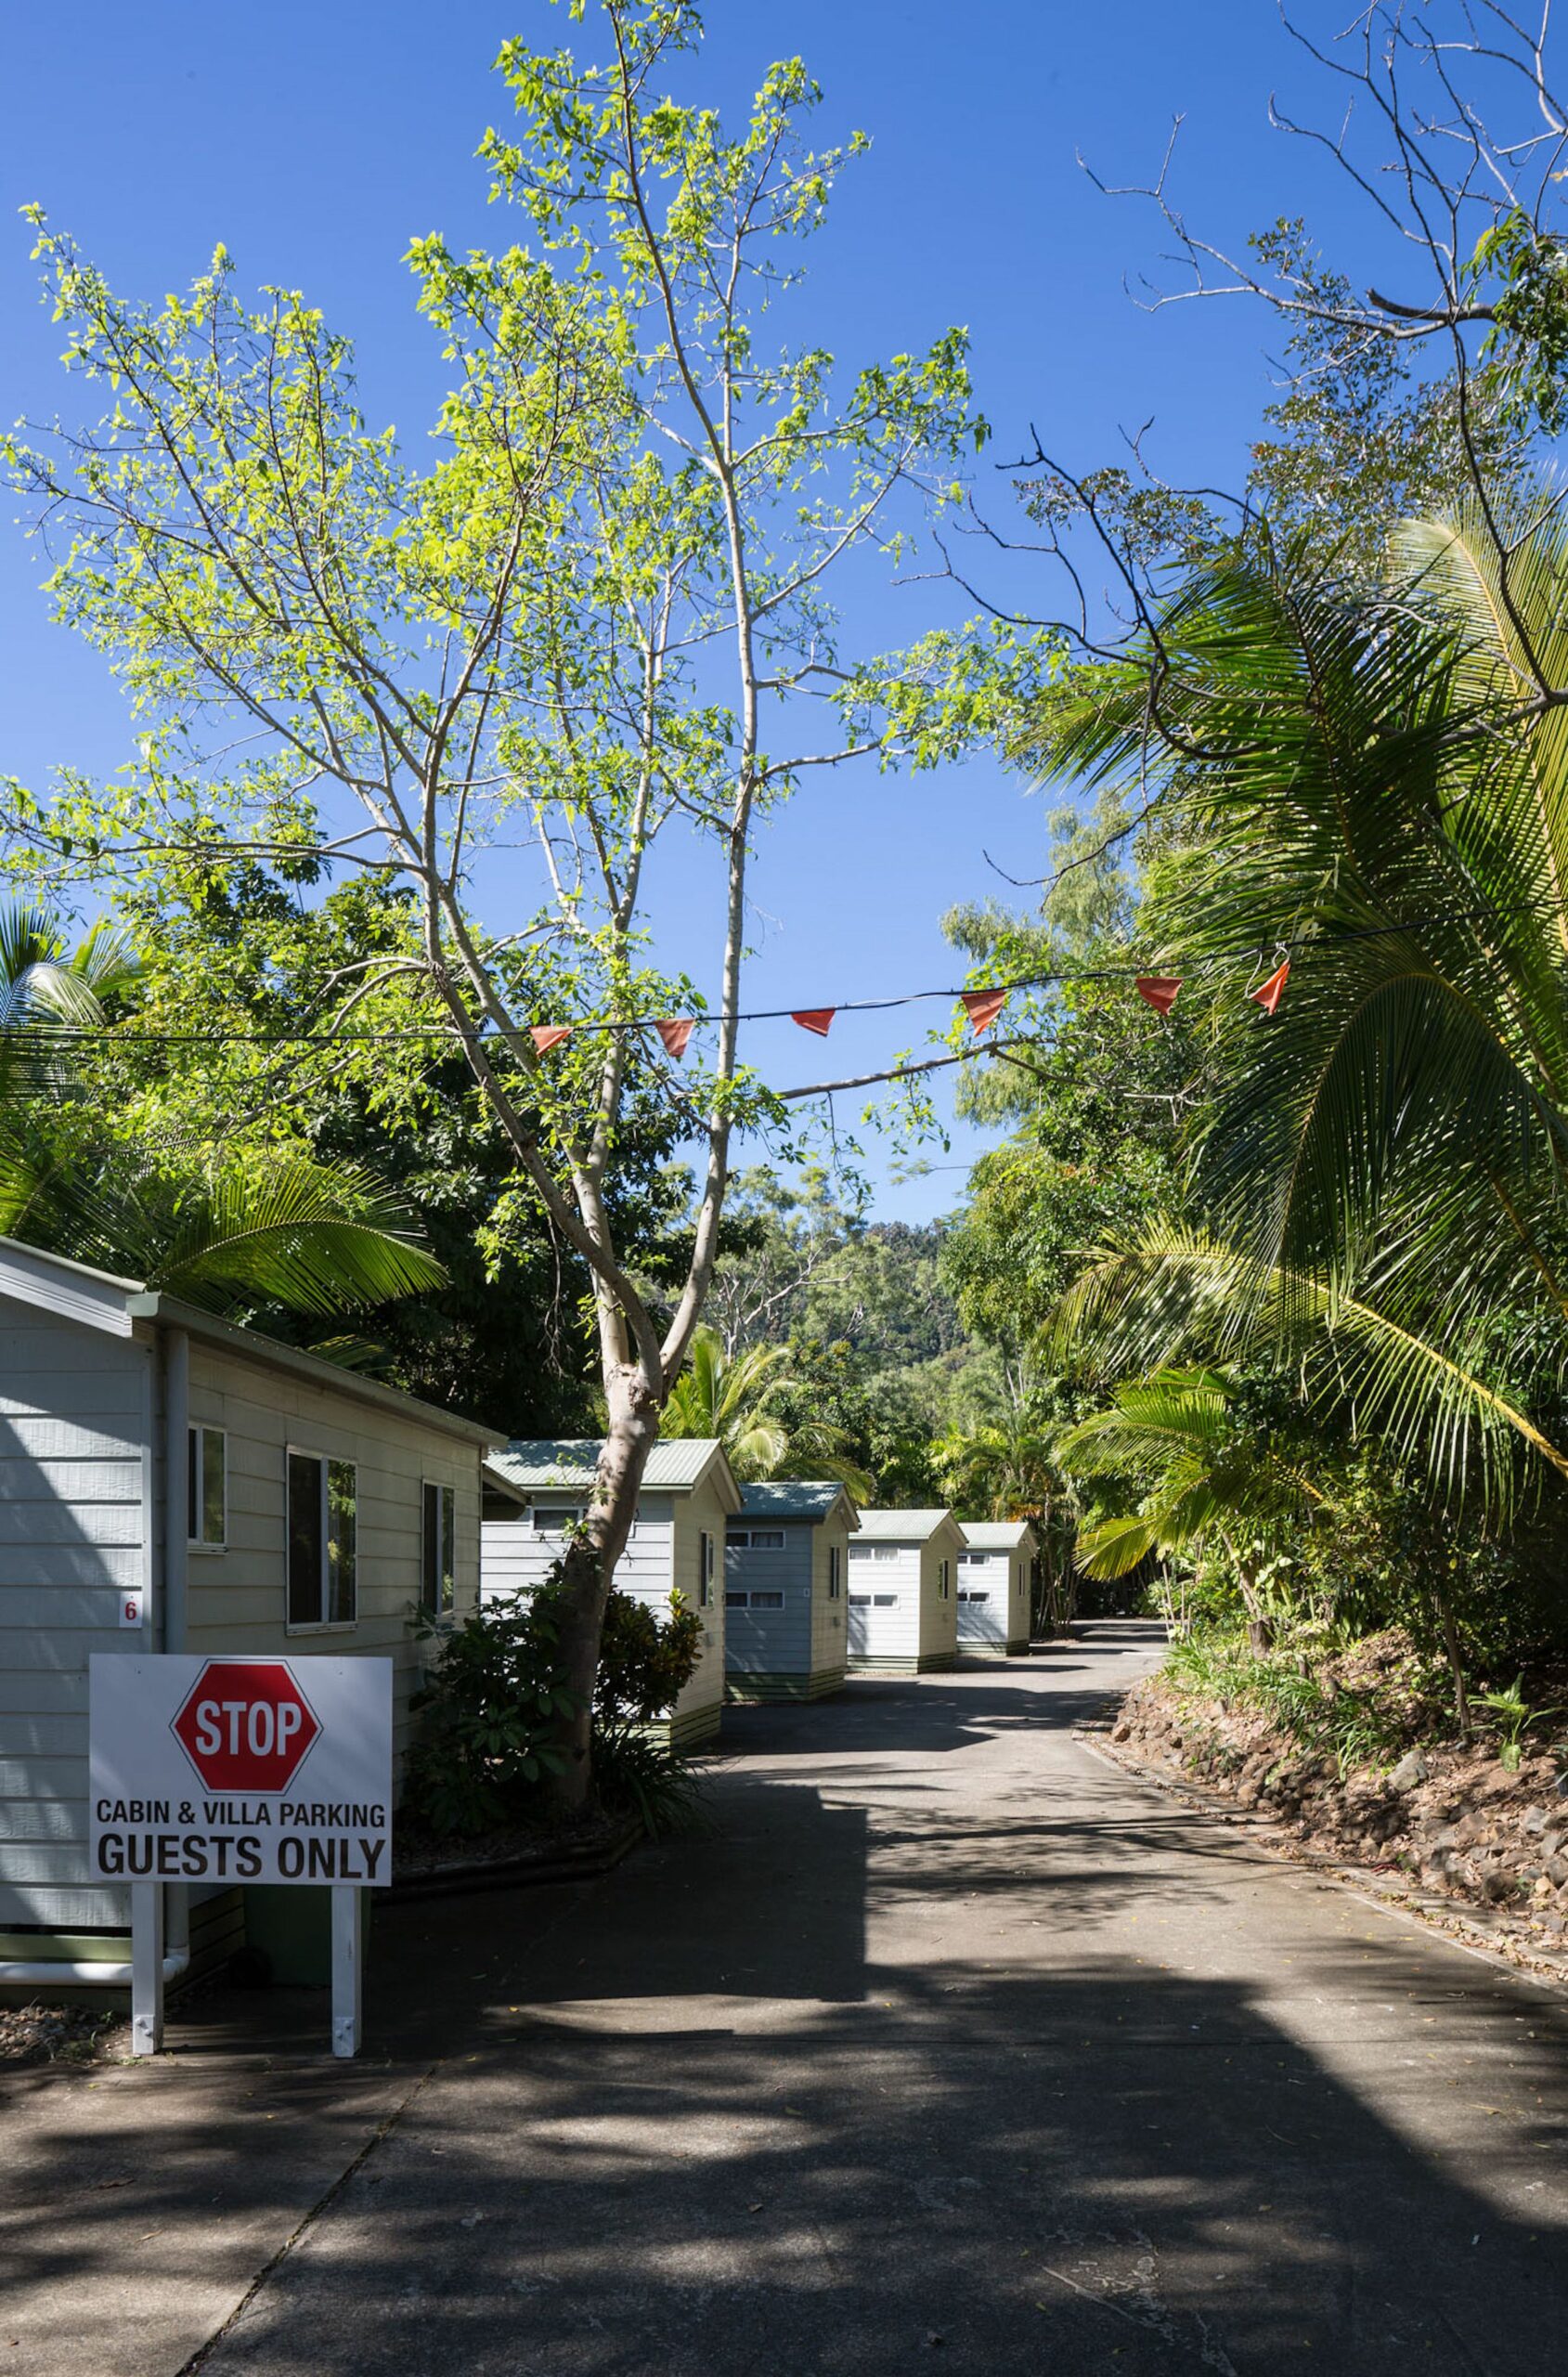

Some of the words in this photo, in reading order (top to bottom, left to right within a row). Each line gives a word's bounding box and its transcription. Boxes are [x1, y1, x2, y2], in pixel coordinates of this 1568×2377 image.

[124, 1601, 137, 1620] 6
[195, 1700, 303, 1757] STOP
[97, 1799, 170, 1824] CABIN
[177, 1800, 196, 1825] &
[203, 1801, 271, 1826] VILLA
[279, 1803, 386, 1828] PARKING
[97, 1833, 263, 1877] GUESTS
[278, 1837, 386, 1880] ONLY
